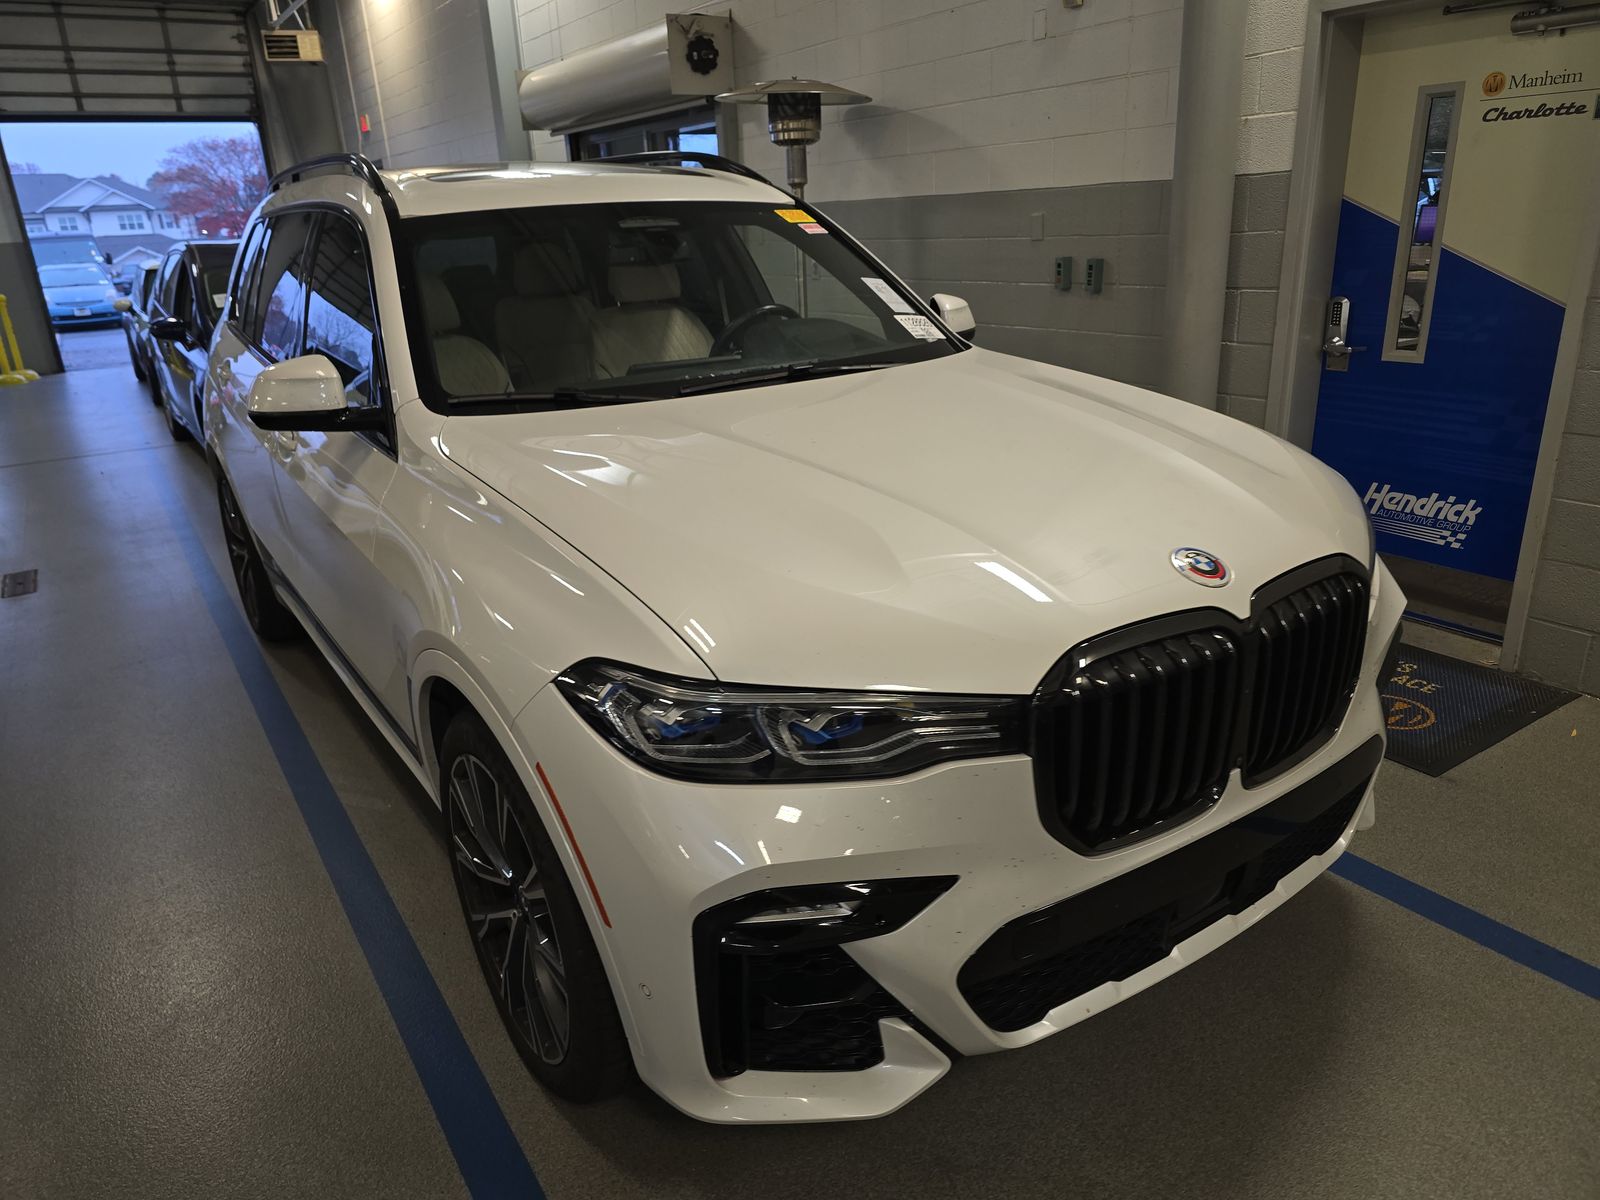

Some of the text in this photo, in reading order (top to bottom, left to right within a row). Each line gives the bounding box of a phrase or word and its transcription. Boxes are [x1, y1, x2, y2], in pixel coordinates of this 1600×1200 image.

[1508, 69, 1583, 90] Manheim
[1482, 101, 1589, 123] Charlotte
[1363, 482, 1483, 526] Hendrick
[1376, 508, 1472, 532] AUTOMOTIVE GROUP
